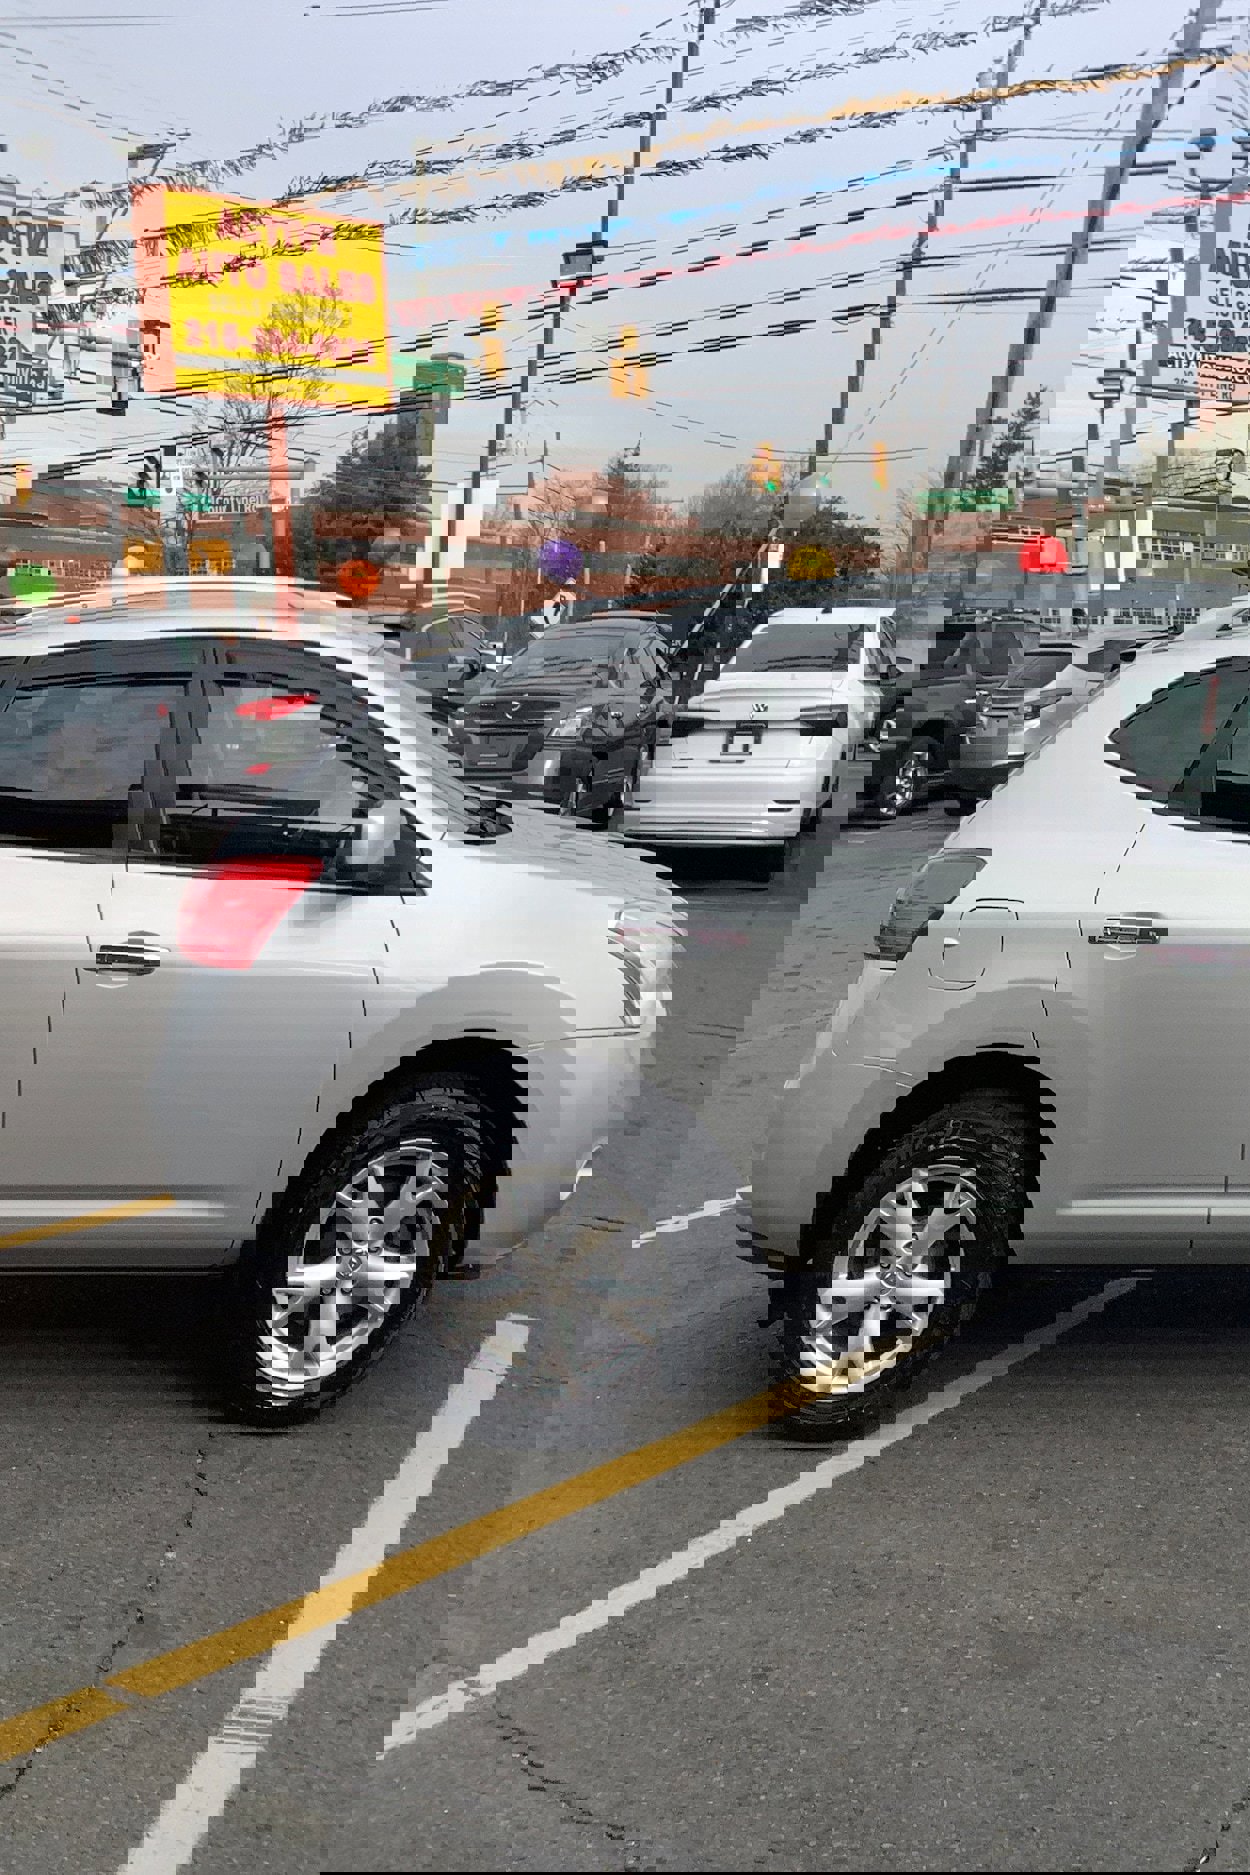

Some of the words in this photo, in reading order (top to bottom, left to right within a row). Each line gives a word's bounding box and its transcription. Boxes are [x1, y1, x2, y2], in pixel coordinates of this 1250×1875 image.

[215, 207, 337, 257] ACTIVE
[175, 246, 268, 290] AUTO
[278, 261, 376, 306] SALES
[208, 293, 262, 318] SELLS
[267, 301, 344, 328] CHEAPER
[184, 317, 376, 367] 215-394-8922
[183, 355, 378, 385] ACTIVEAUTOHATBORO.COM
[442, 370, 462, 389] Rd
[221, 378, 242, 391] 300
[246, 380, 252, 392] E
[256, 381, 302, 396] COUNTY
[306, 385, 331, 399] LINE
[334, 388, 348, 401] RD
[919, 495, 963, 510] County
[967, 493, 993, 507] Line
[995, 492, 1011, 506] Rd
